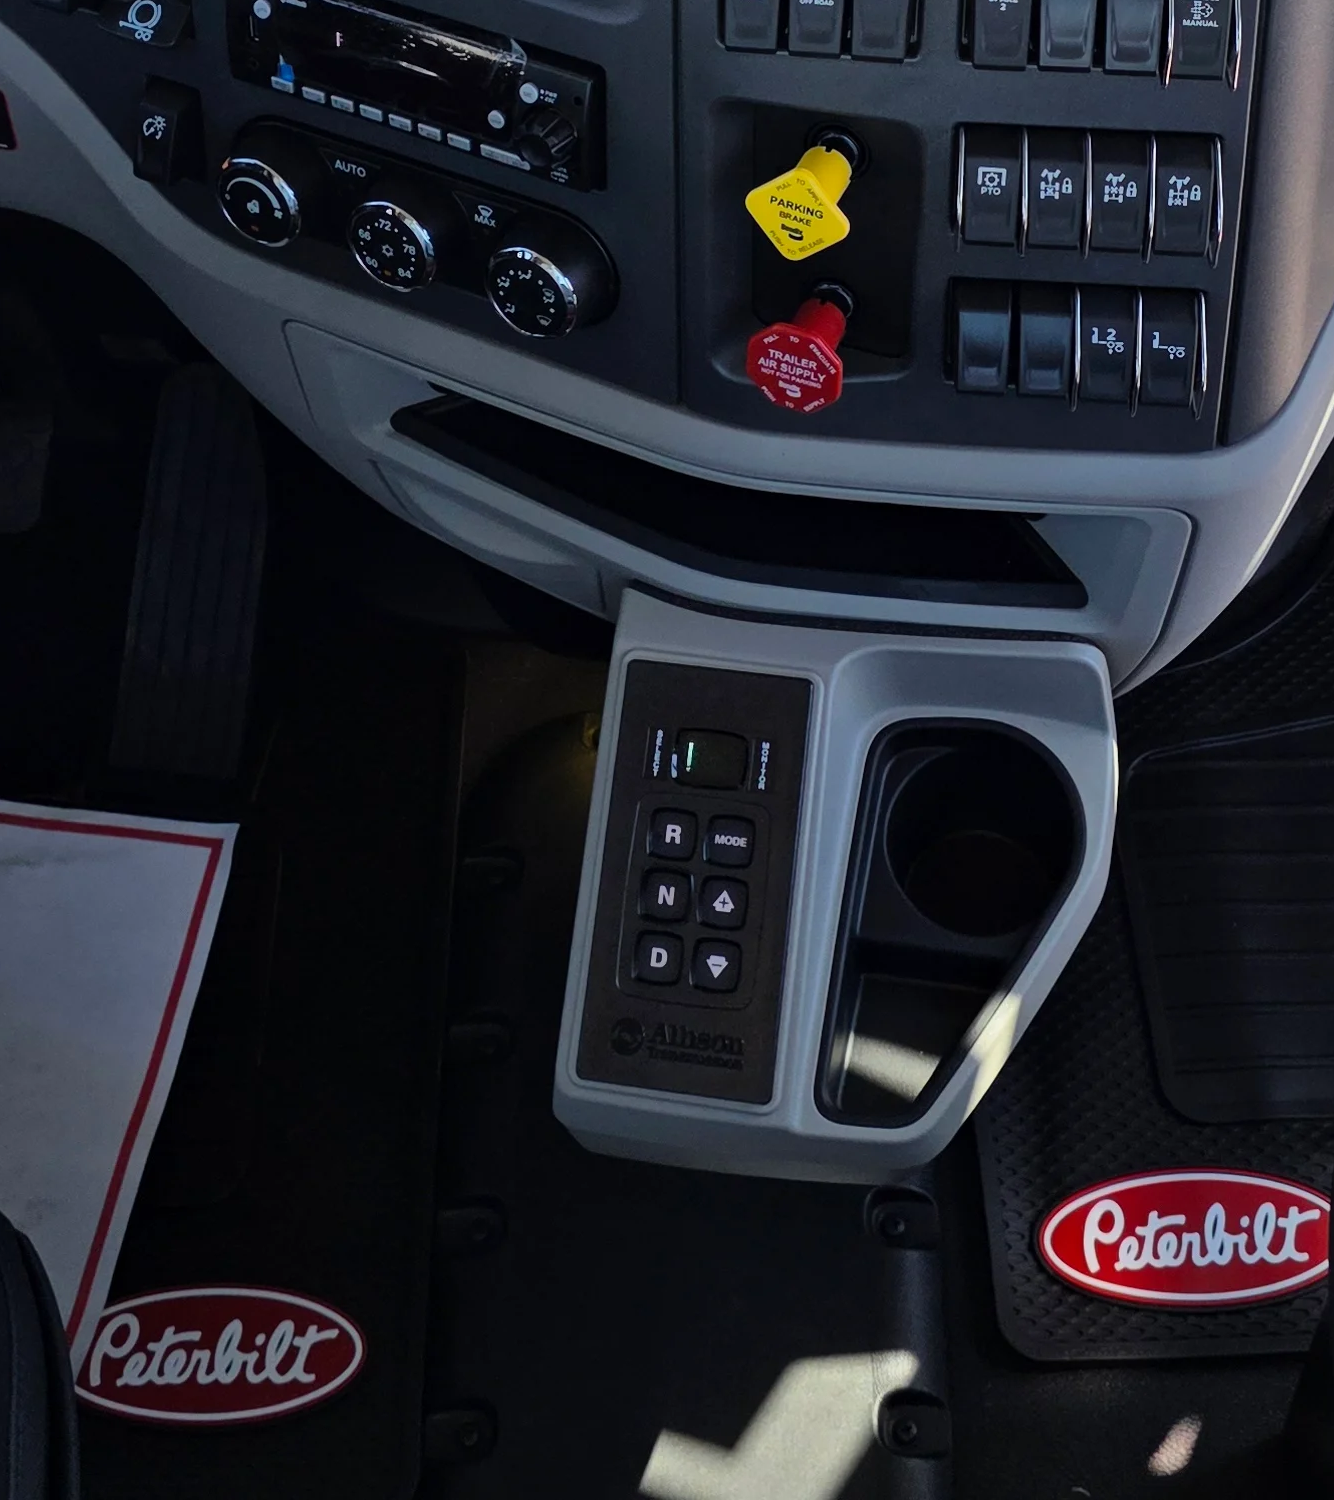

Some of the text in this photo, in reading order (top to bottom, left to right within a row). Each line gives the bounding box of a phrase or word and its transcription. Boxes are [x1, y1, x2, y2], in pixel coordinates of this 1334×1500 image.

[999, 3, 1007, 11] 2
[1182, 18, 1219, 28] MANUAL
[334, 158, 367, 179] AUTO
[776, 178, 824, 208] PULL TO APPLY
[980, 187, 1001, 196] PTO
[769, 195, 824, 219] PARKING
[379, 219, 392, 231] 72
[474, 213, 496, 228] MAX
[779, 211, 812, 227] BRAKE
[358, 228, 372, 242] 66
[402, 243, 416, 256] 78
[787, 248, 797, 256] TO
[798, 238, 825, 253] RELEASE
[365, 256, 379, 269] 60
[397, 267, 412, 280] 84
[768, 348, 817, 371] TRAILER
[789, 336, 800, 344] TO
[809, 343, 837, 375] EVACUATE
[758, 357, 826, 383] AIR SUPPLY
[761, 367, 822, 389] NOT FOR PARKING
[757, 741, 770, 790] MONITOR
[665, 824, 682, 844] R
[714, 834, 747, 848] MODE
[657, 885, 675, 906] N
[649, 947, 668, 968] D
[647, 1022, 745, 1056] Allison
[1083, 1198, 1321, 1274] Peterbilt
[89, 1312, 340, 1387] Peterbilt
